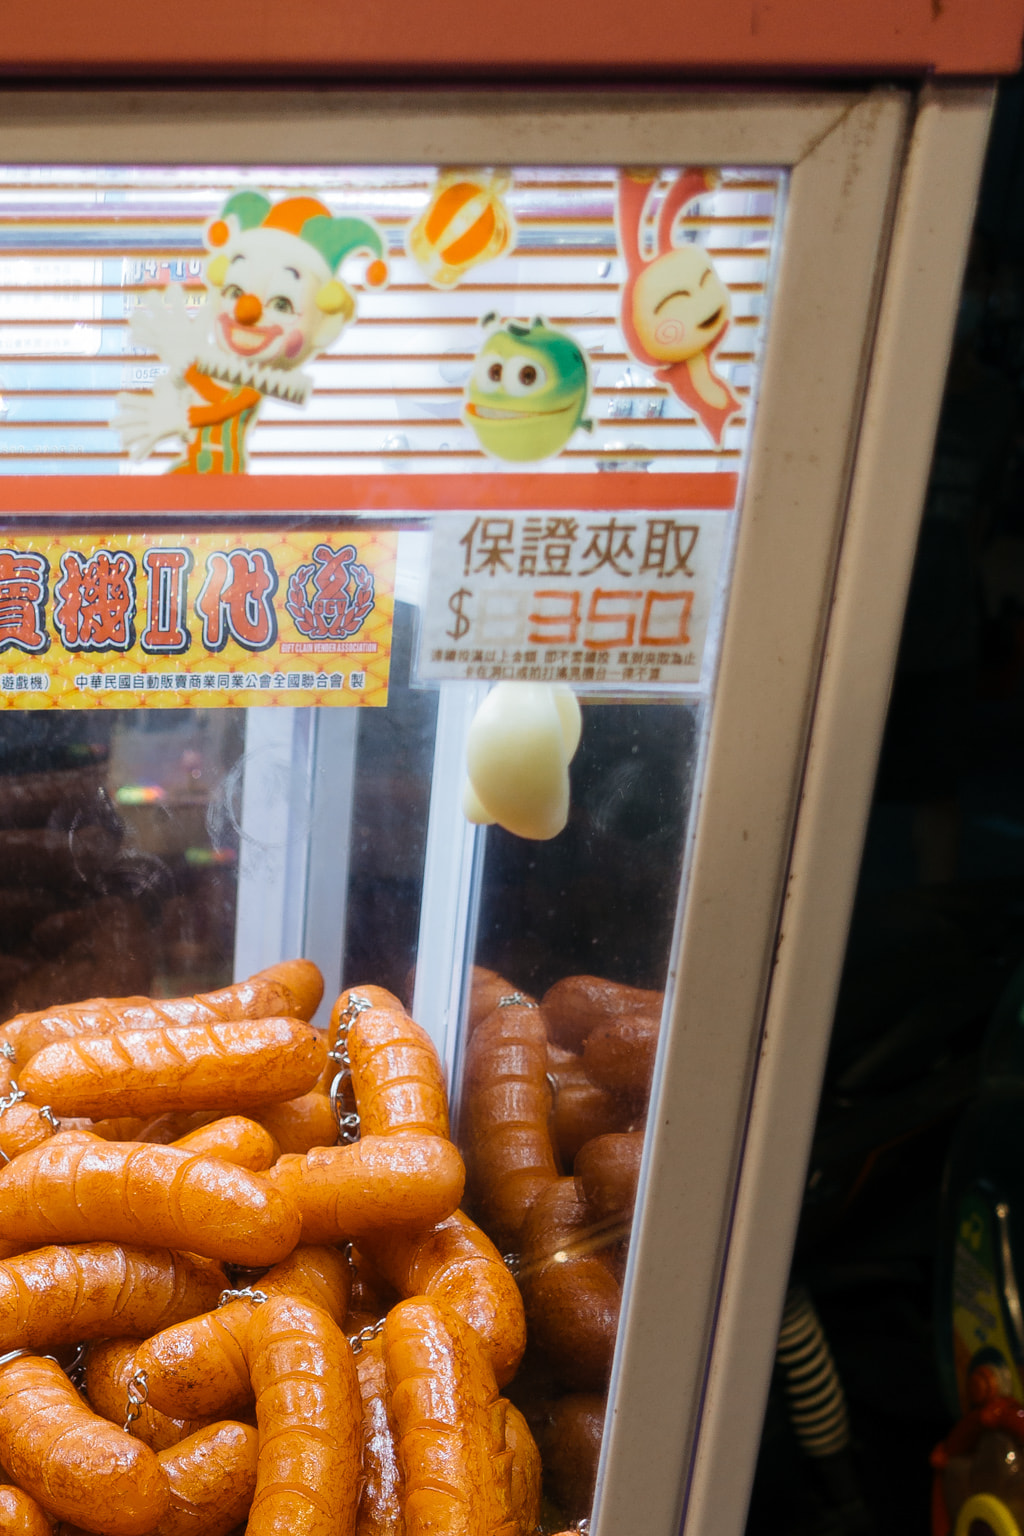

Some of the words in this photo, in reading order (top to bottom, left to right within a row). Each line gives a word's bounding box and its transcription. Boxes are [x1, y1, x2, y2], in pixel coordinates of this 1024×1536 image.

[460, 516, 700, 578] 保證夾取
[446, 587, 473, 641] $
[528, 587, 695, 649] 350
[75, 672, 343, 691] 中華民國自動販賣商業同業公會全國聯合會
[351, 671, 364, 689] 製
